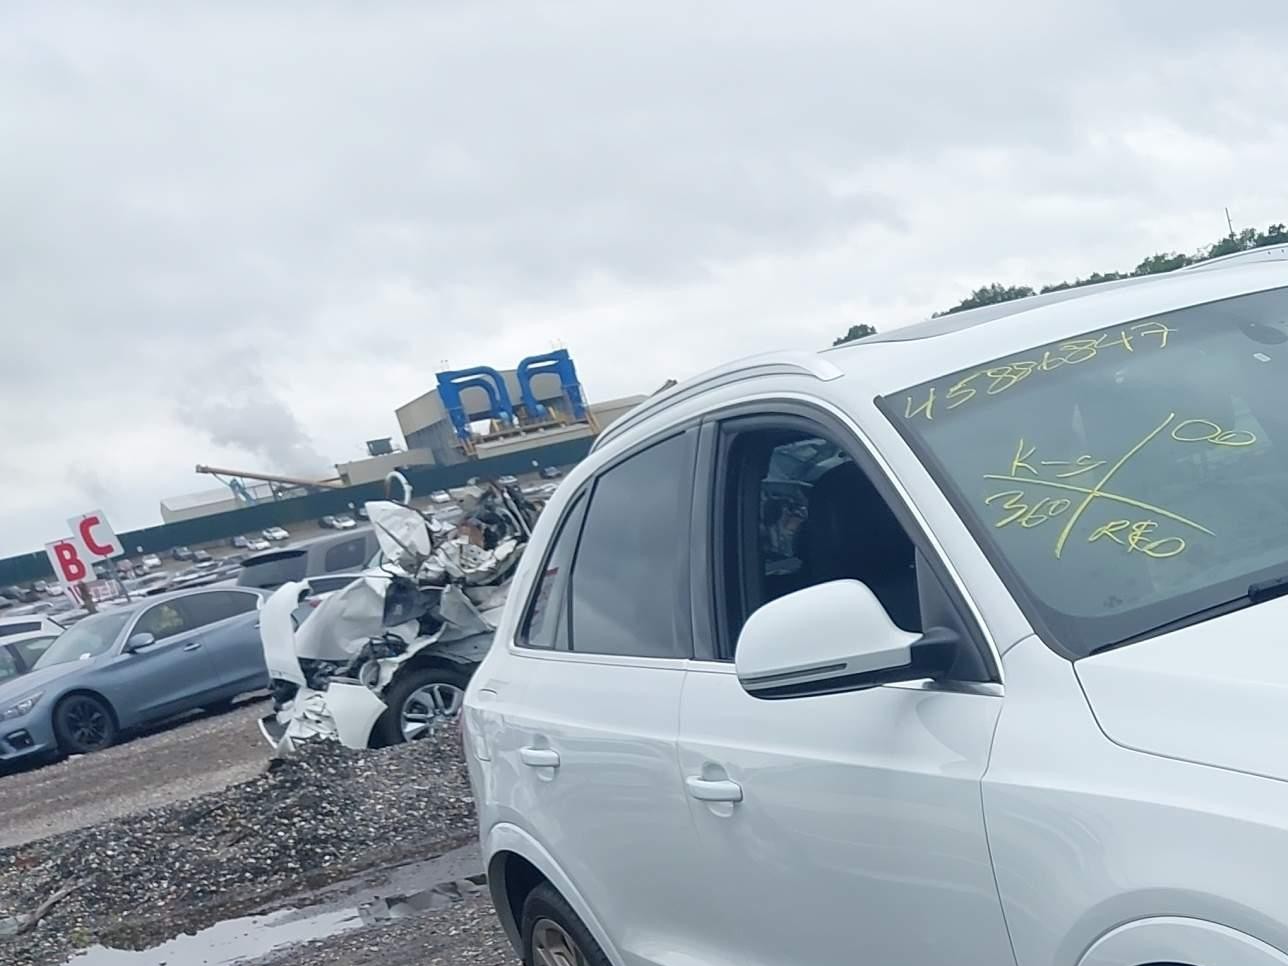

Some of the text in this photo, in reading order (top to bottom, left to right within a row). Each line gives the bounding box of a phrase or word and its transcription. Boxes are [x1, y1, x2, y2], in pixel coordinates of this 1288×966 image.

[984, 490, 1071, 528] 360
[80, 516, 114, 556] C
[54, 543, 86, 582] B
